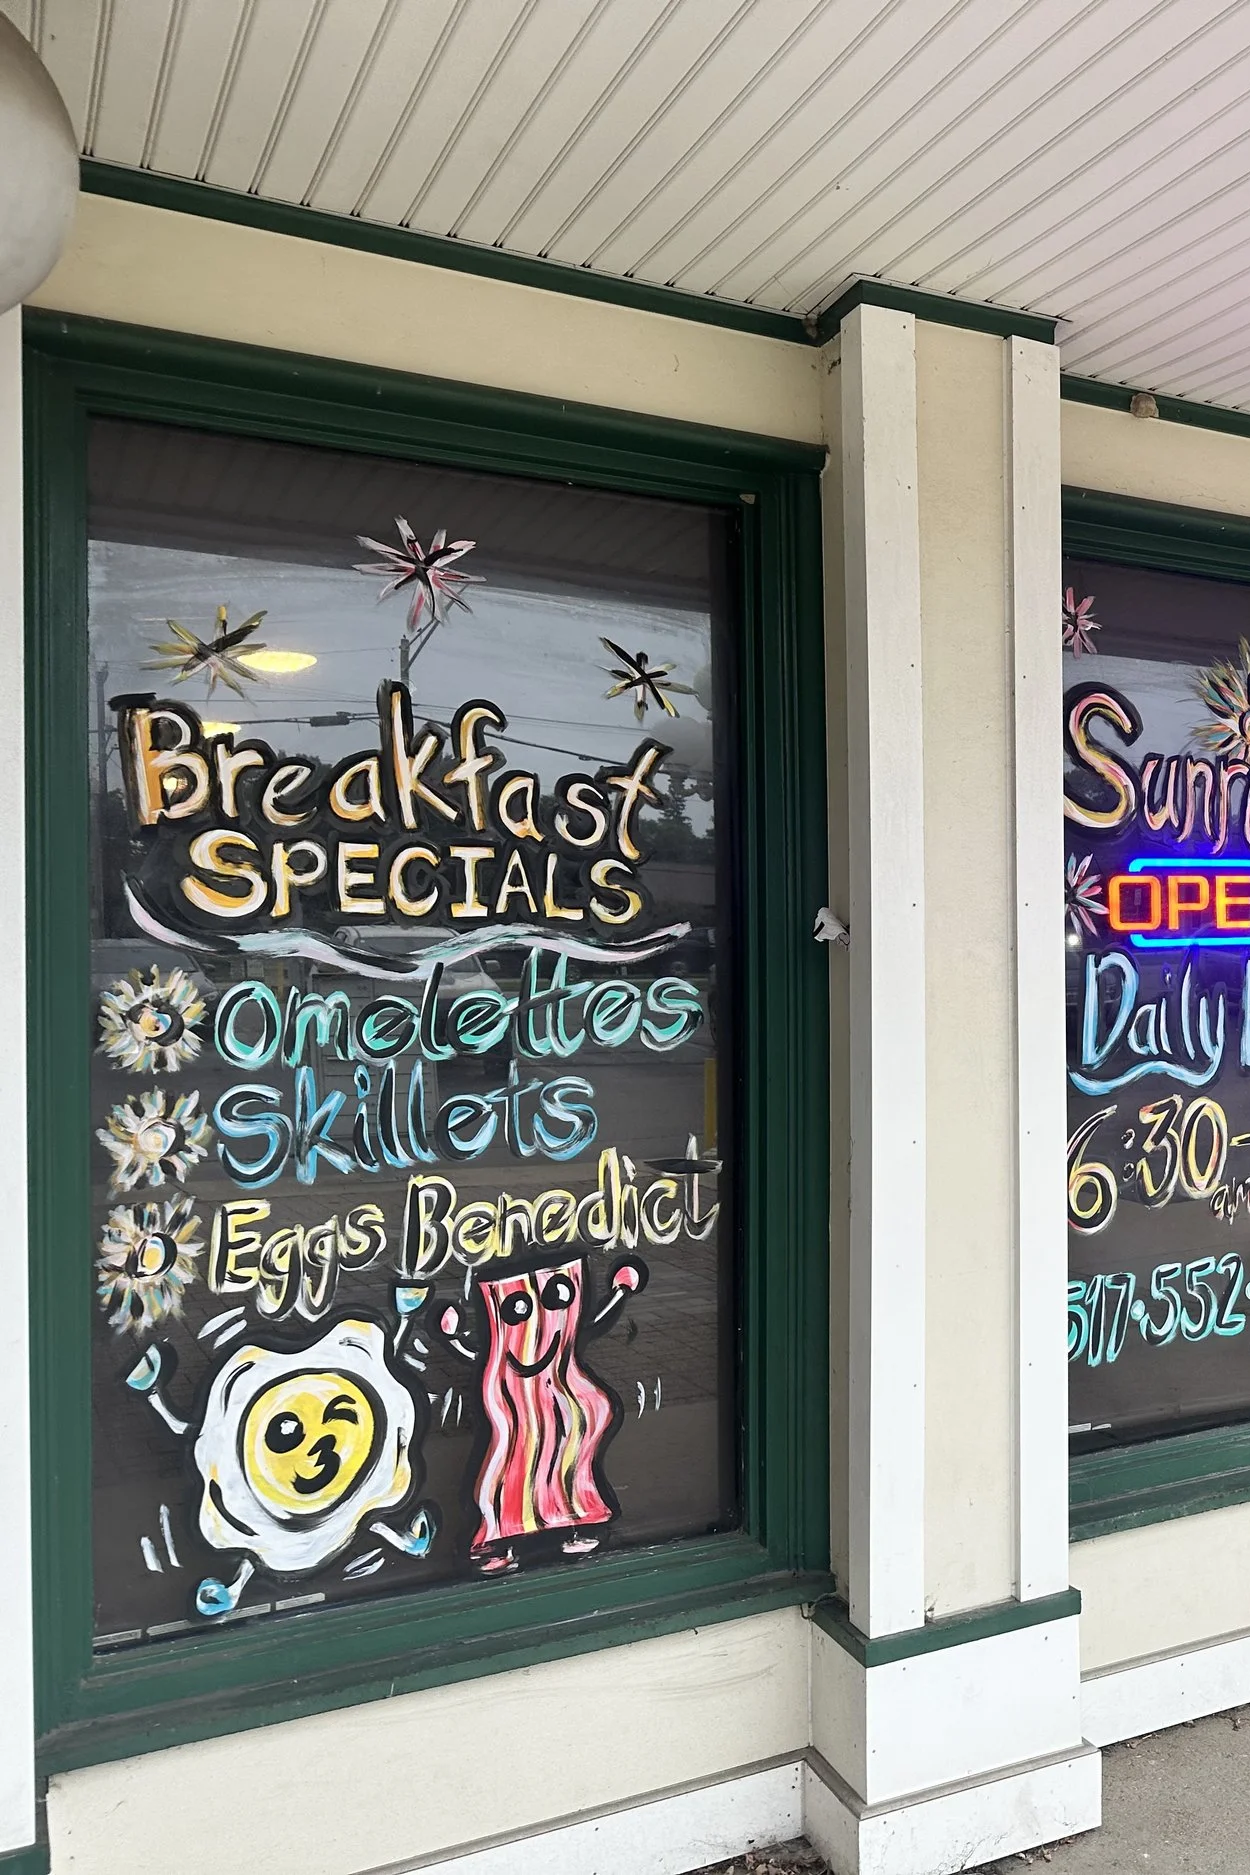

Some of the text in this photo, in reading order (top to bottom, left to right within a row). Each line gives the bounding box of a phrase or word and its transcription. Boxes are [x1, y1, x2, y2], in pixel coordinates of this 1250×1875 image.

[125, 684, 671, 864] Breakfast
[181, 829, 642, 924] SPECIALS
[1068, 952, 1226, 1095] Daily
[214, 1058, 598, 1188] Skillets
[210, 1134, 723, 1322] Eggs Benedict
